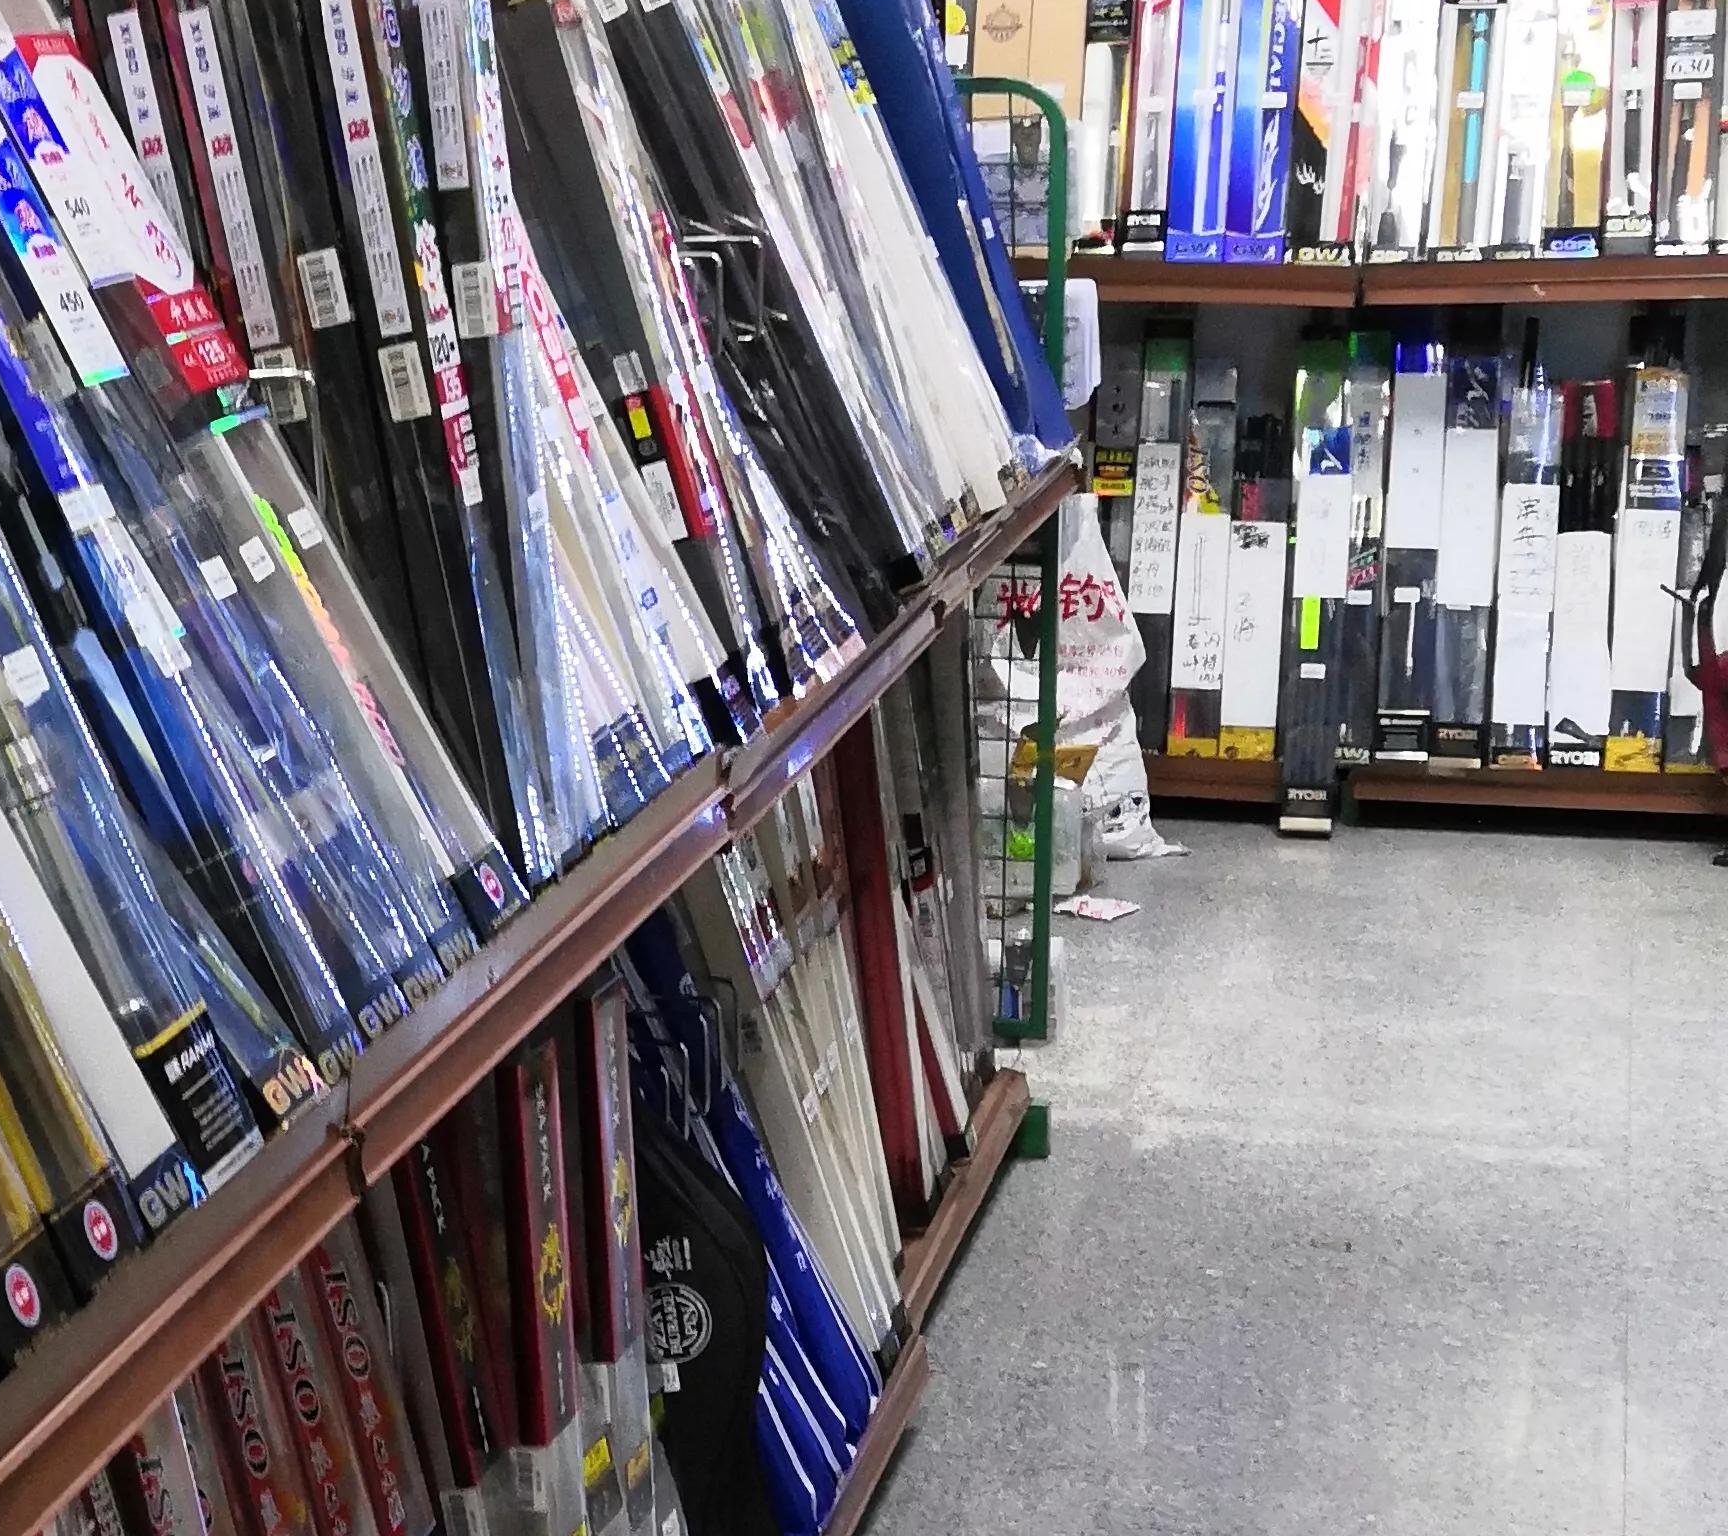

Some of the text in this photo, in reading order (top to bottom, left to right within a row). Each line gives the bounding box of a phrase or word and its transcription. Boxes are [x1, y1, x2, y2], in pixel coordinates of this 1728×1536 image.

[1670, 57, 1712, 73] 630
[64, 196, 91, 221] 540
[58, 290, 85, 315] 450
[1438, 727, 1479, 741] RYOBI
[1550, 749, 1601, 767] RYOBI
[1287, 787, 1328, 802] RYOBI
[321, 1263, 371, 1382] ISO
[272, 1307, 322, 1427] ISO
[222, 1354, 269, 1479] ISO
